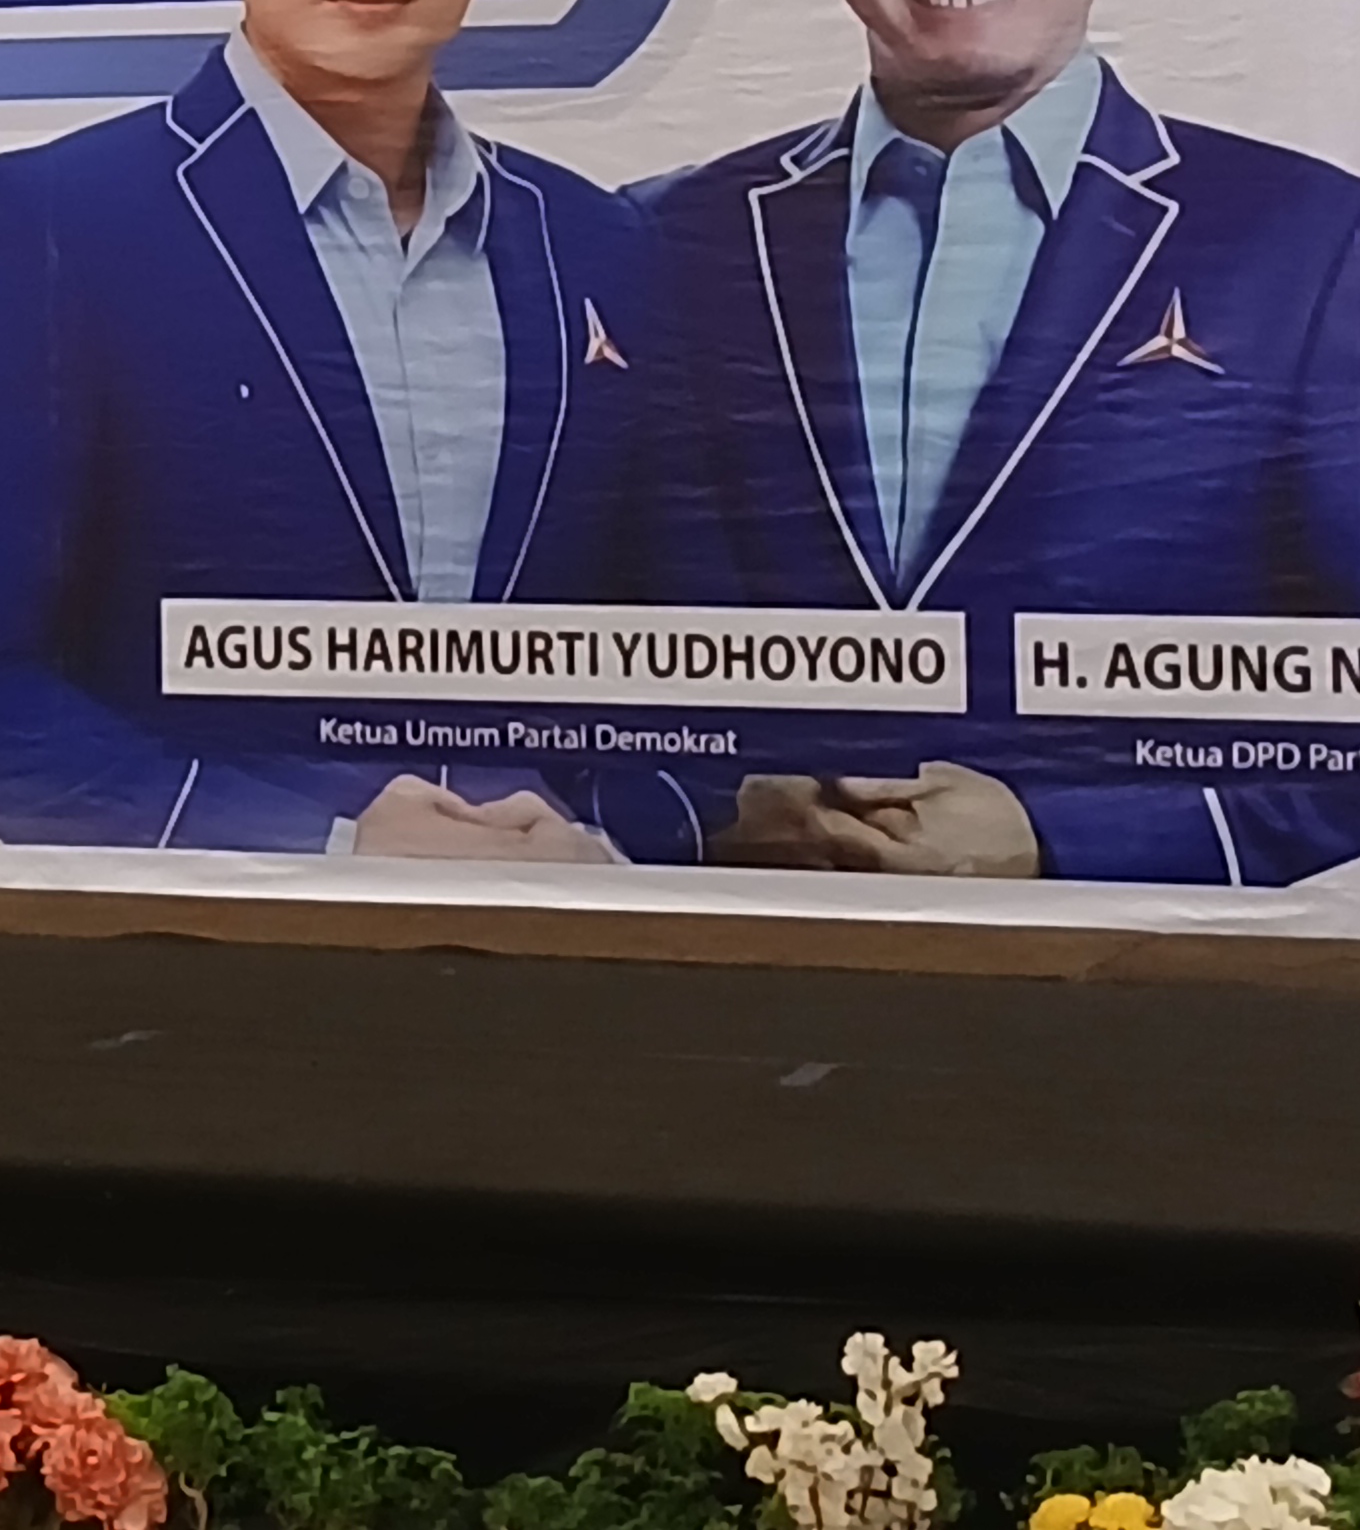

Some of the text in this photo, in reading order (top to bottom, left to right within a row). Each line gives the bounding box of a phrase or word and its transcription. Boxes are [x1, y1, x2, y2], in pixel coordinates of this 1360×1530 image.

[183, 624, 946, 685] AGUS HARIMURTI YUDHOYONO
[1033, 640, 1088, 689] H.
[1103, 642, 1312, 693] AGUNG
[319, 717, 398, 745] Ketua
[405, 719, 501, 748] Umum
[594, 723, 738, 755] Demokrat
[1135, 738, 1360, 772] Ketua DPD Par
